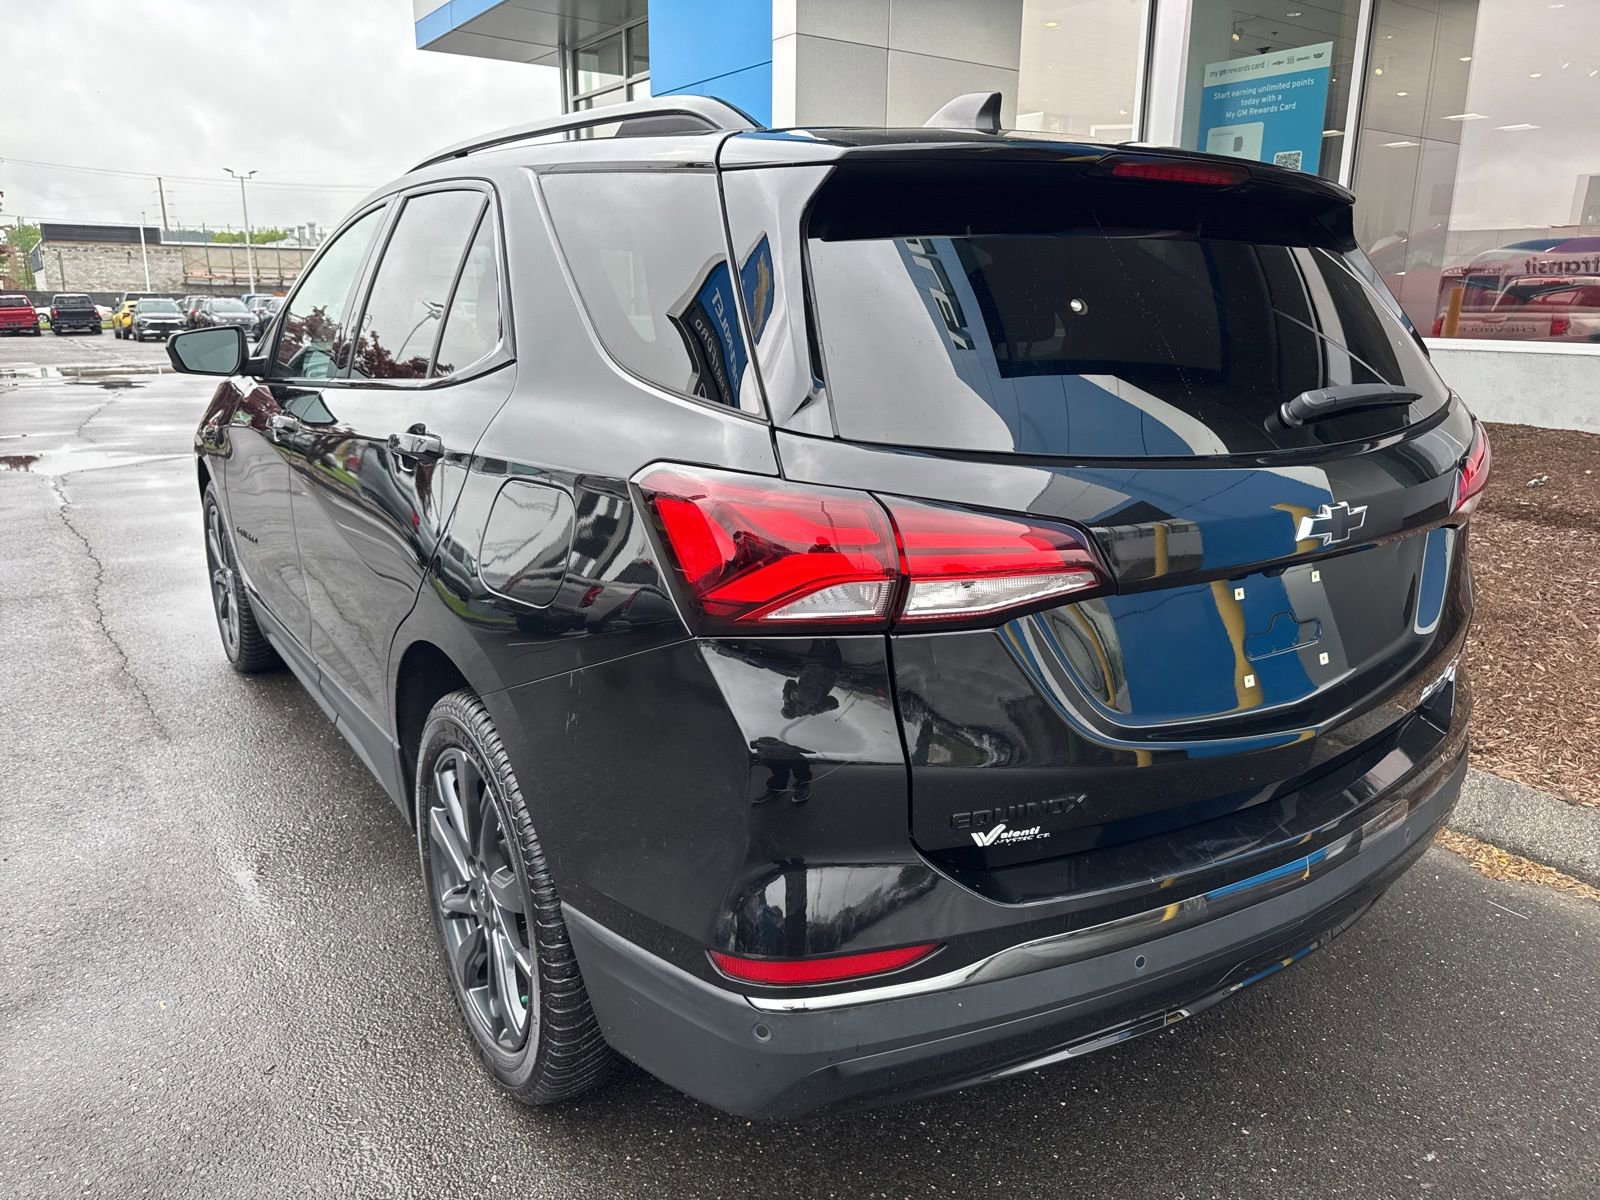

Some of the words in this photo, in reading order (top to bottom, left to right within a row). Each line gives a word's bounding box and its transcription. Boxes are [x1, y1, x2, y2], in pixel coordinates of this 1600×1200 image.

[1251, 62, 1265, 71] card
[1213, 91, 1230, 100] Start
[1231, 87, 1257, 97] earning
[1257, 81, 1291, 93] unlimited
[1291, 78, 1315, 89] points
[1225, 111, 1236, 119] My
[1236, 109, 1248, 117] GM
[1249, 105, 1278, 115] Rewards
[1279, 102, 1297, 111] Card
[1240, 97, 1260, 107] today
[1261, 95, 1276, 103] with
[951, 793, 1088, 829] EQUINOX
[970, 823, 1041, 847] Valenti
